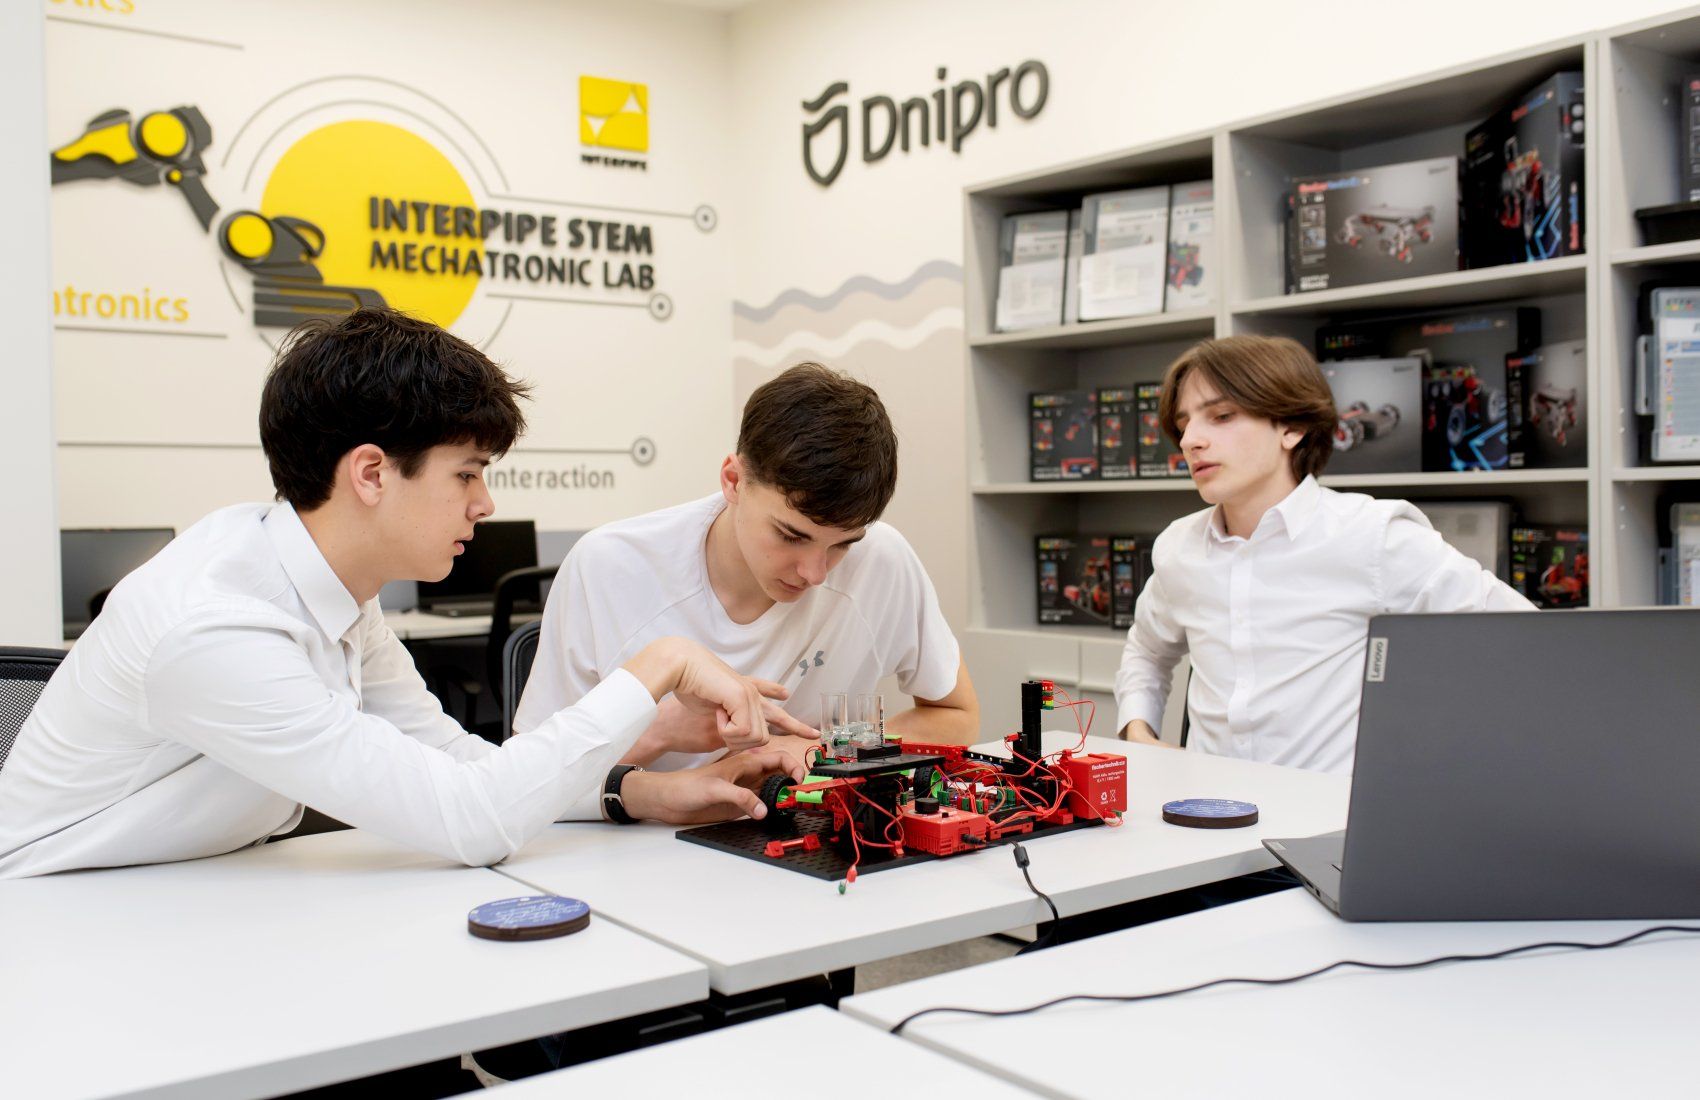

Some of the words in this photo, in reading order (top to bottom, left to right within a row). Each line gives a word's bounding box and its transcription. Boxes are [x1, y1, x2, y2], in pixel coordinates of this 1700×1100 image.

[861, 59, 1050, 164] Dnipro
[581, 154, 647, 171] INTERPIPE
[369, 196, 557, 246] INTERPIPE
[568, 218, 653, 255] STEM
[369, 240, 592, 287] MECHATRONIC
[603, 261, 656, 291] LAB
[487, 464, 616, 489] interaction
[1371, 641, 1384, 678] Lenovo
